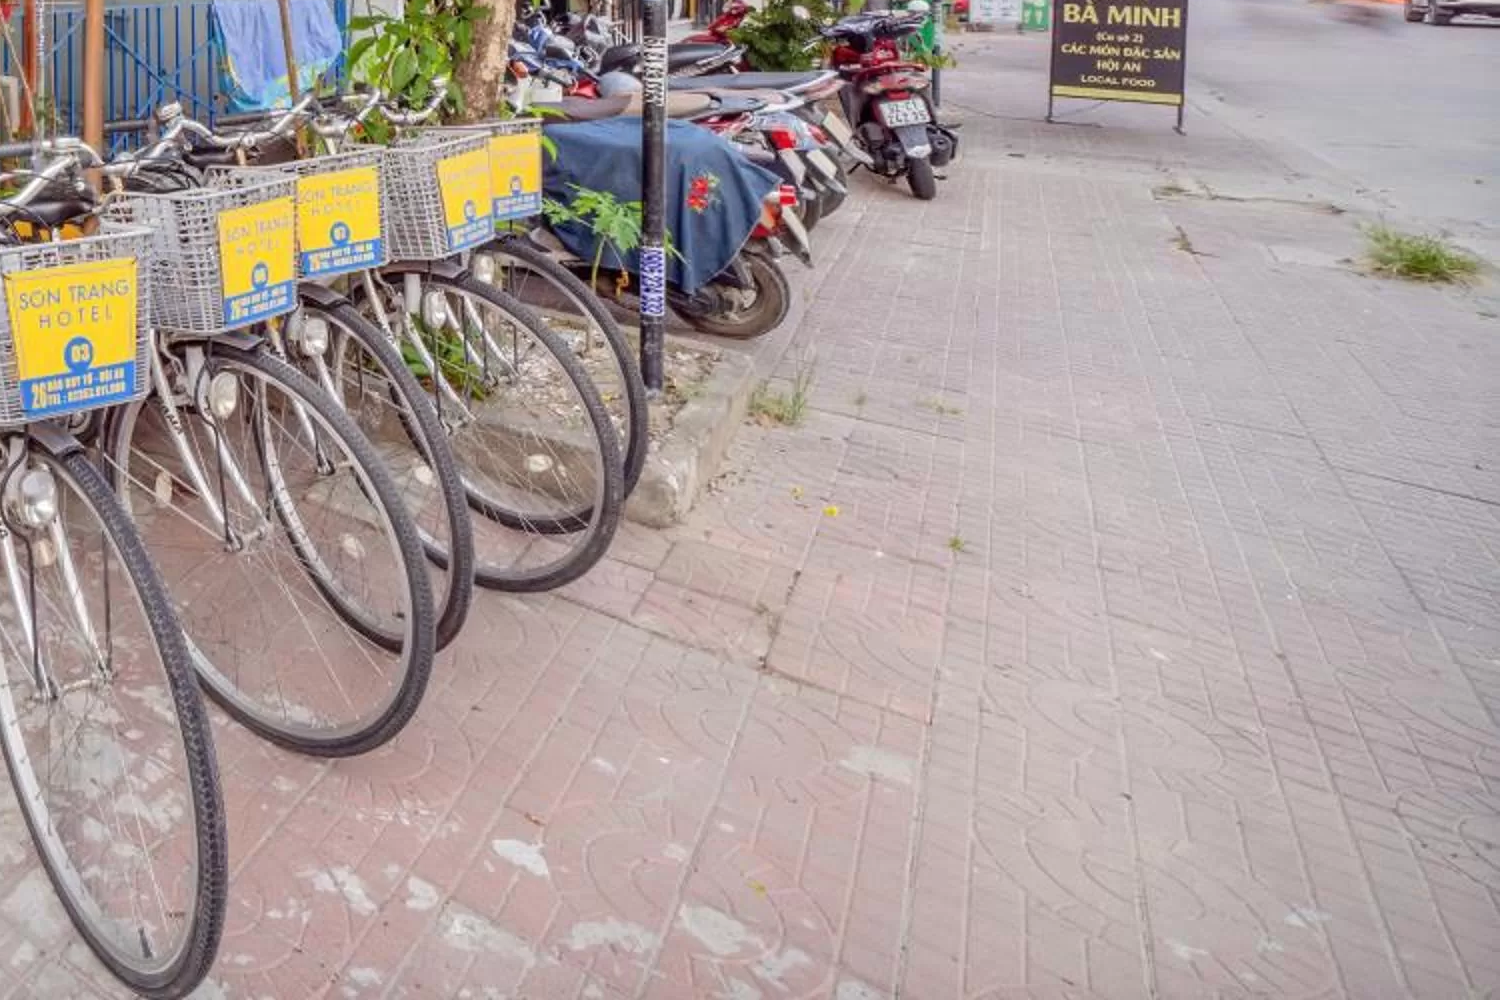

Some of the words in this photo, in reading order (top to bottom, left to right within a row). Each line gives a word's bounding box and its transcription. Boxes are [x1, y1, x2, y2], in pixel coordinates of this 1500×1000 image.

[1107, 5, 1181, 28] MINH
[1123, 61, 1142, 73] AN
[1081, 75, 1120, 86] LOCAL
[1122, 77, 1157, 88] FOOD
[68, 279, 130, 304] TRANG
[39, 304, 113, 329] HOTEL
